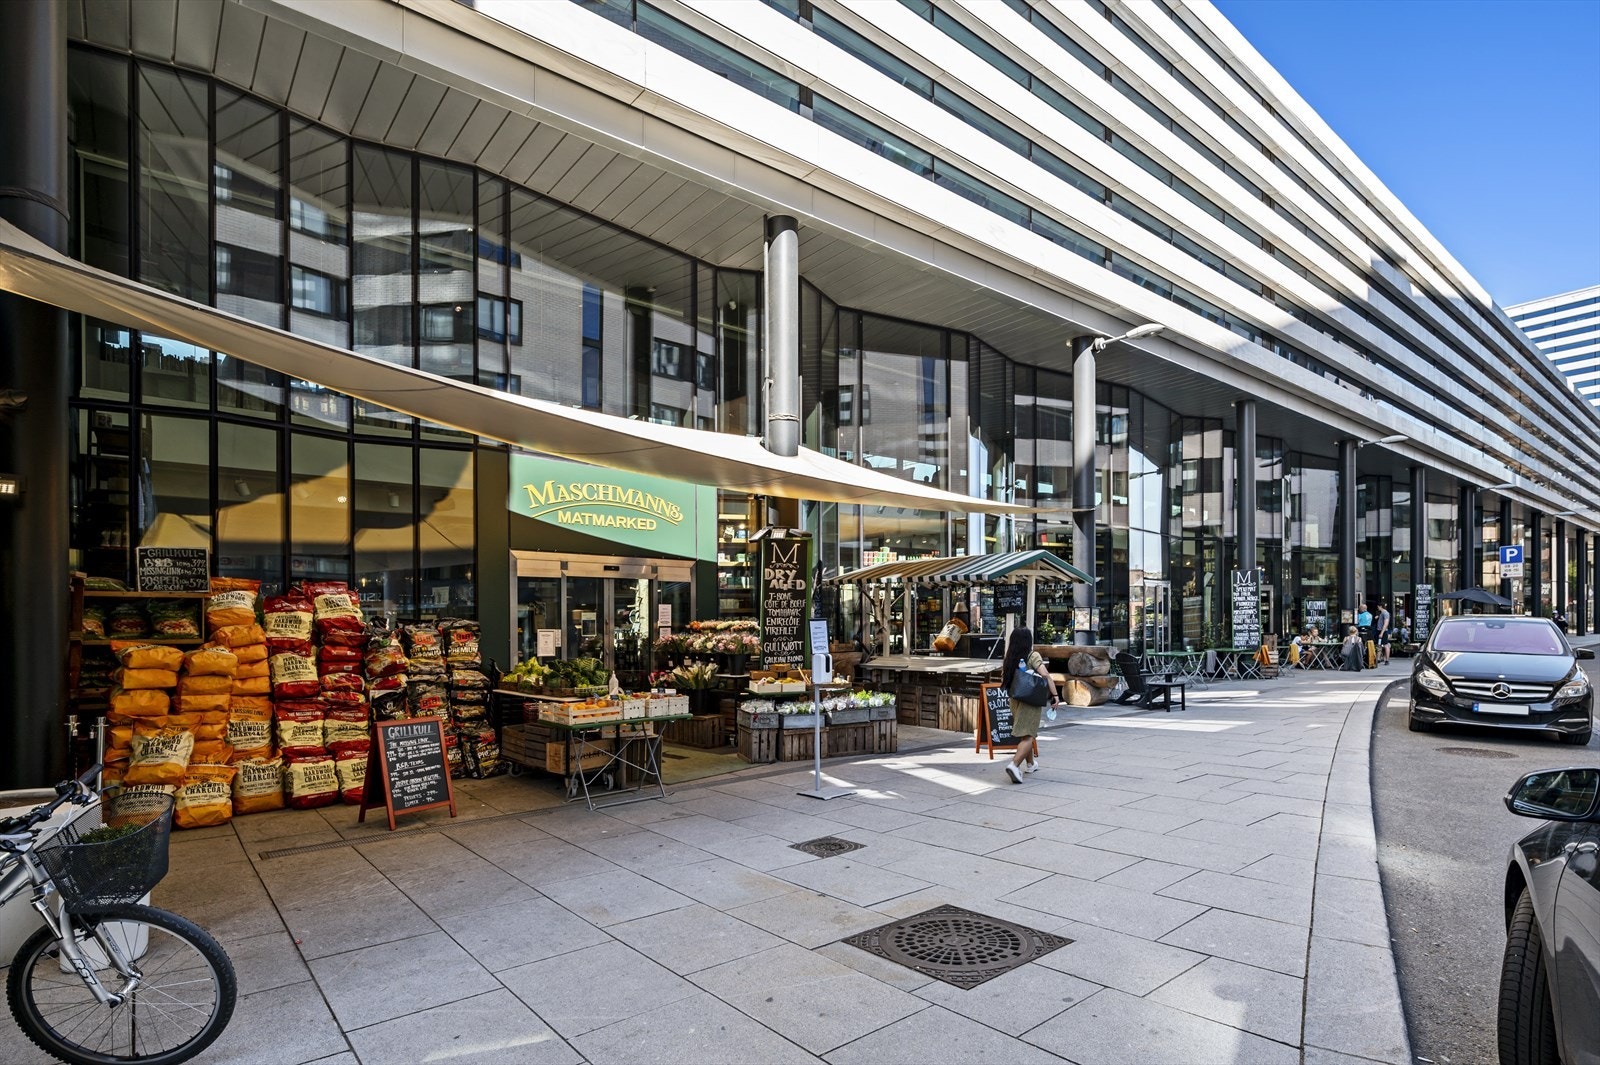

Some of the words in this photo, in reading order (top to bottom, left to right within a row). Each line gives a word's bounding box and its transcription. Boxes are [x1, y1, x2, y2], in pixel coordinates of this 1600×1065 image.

[523, 480, 684, 522] MASCHMANNS
[558, 511, 657, 531] MATMARKED
[771, 542, 800, 563] M
[1506, 548, 1518, 562] P
[764, 568, 797, 580] DRY
[1237, 571, 1251, 583] M
[769, 579, 806, 590] AGED
[781, 600, 787, 608] DE
[767, 608, 801, 616] TOMAHAWK
[764, 641, 804, 653] GULLKJØTT
[388, 725, 431, 739] GRILLKULL
[303, 768, 332, 776] HARDWOOD
[242, 774, 278, 783] CHARCOAL
[305, 774, 333, 783] CHARCOAL
[185, 787, 225, 795] CHARCOAL
[69, 959, 97, 985] RST
